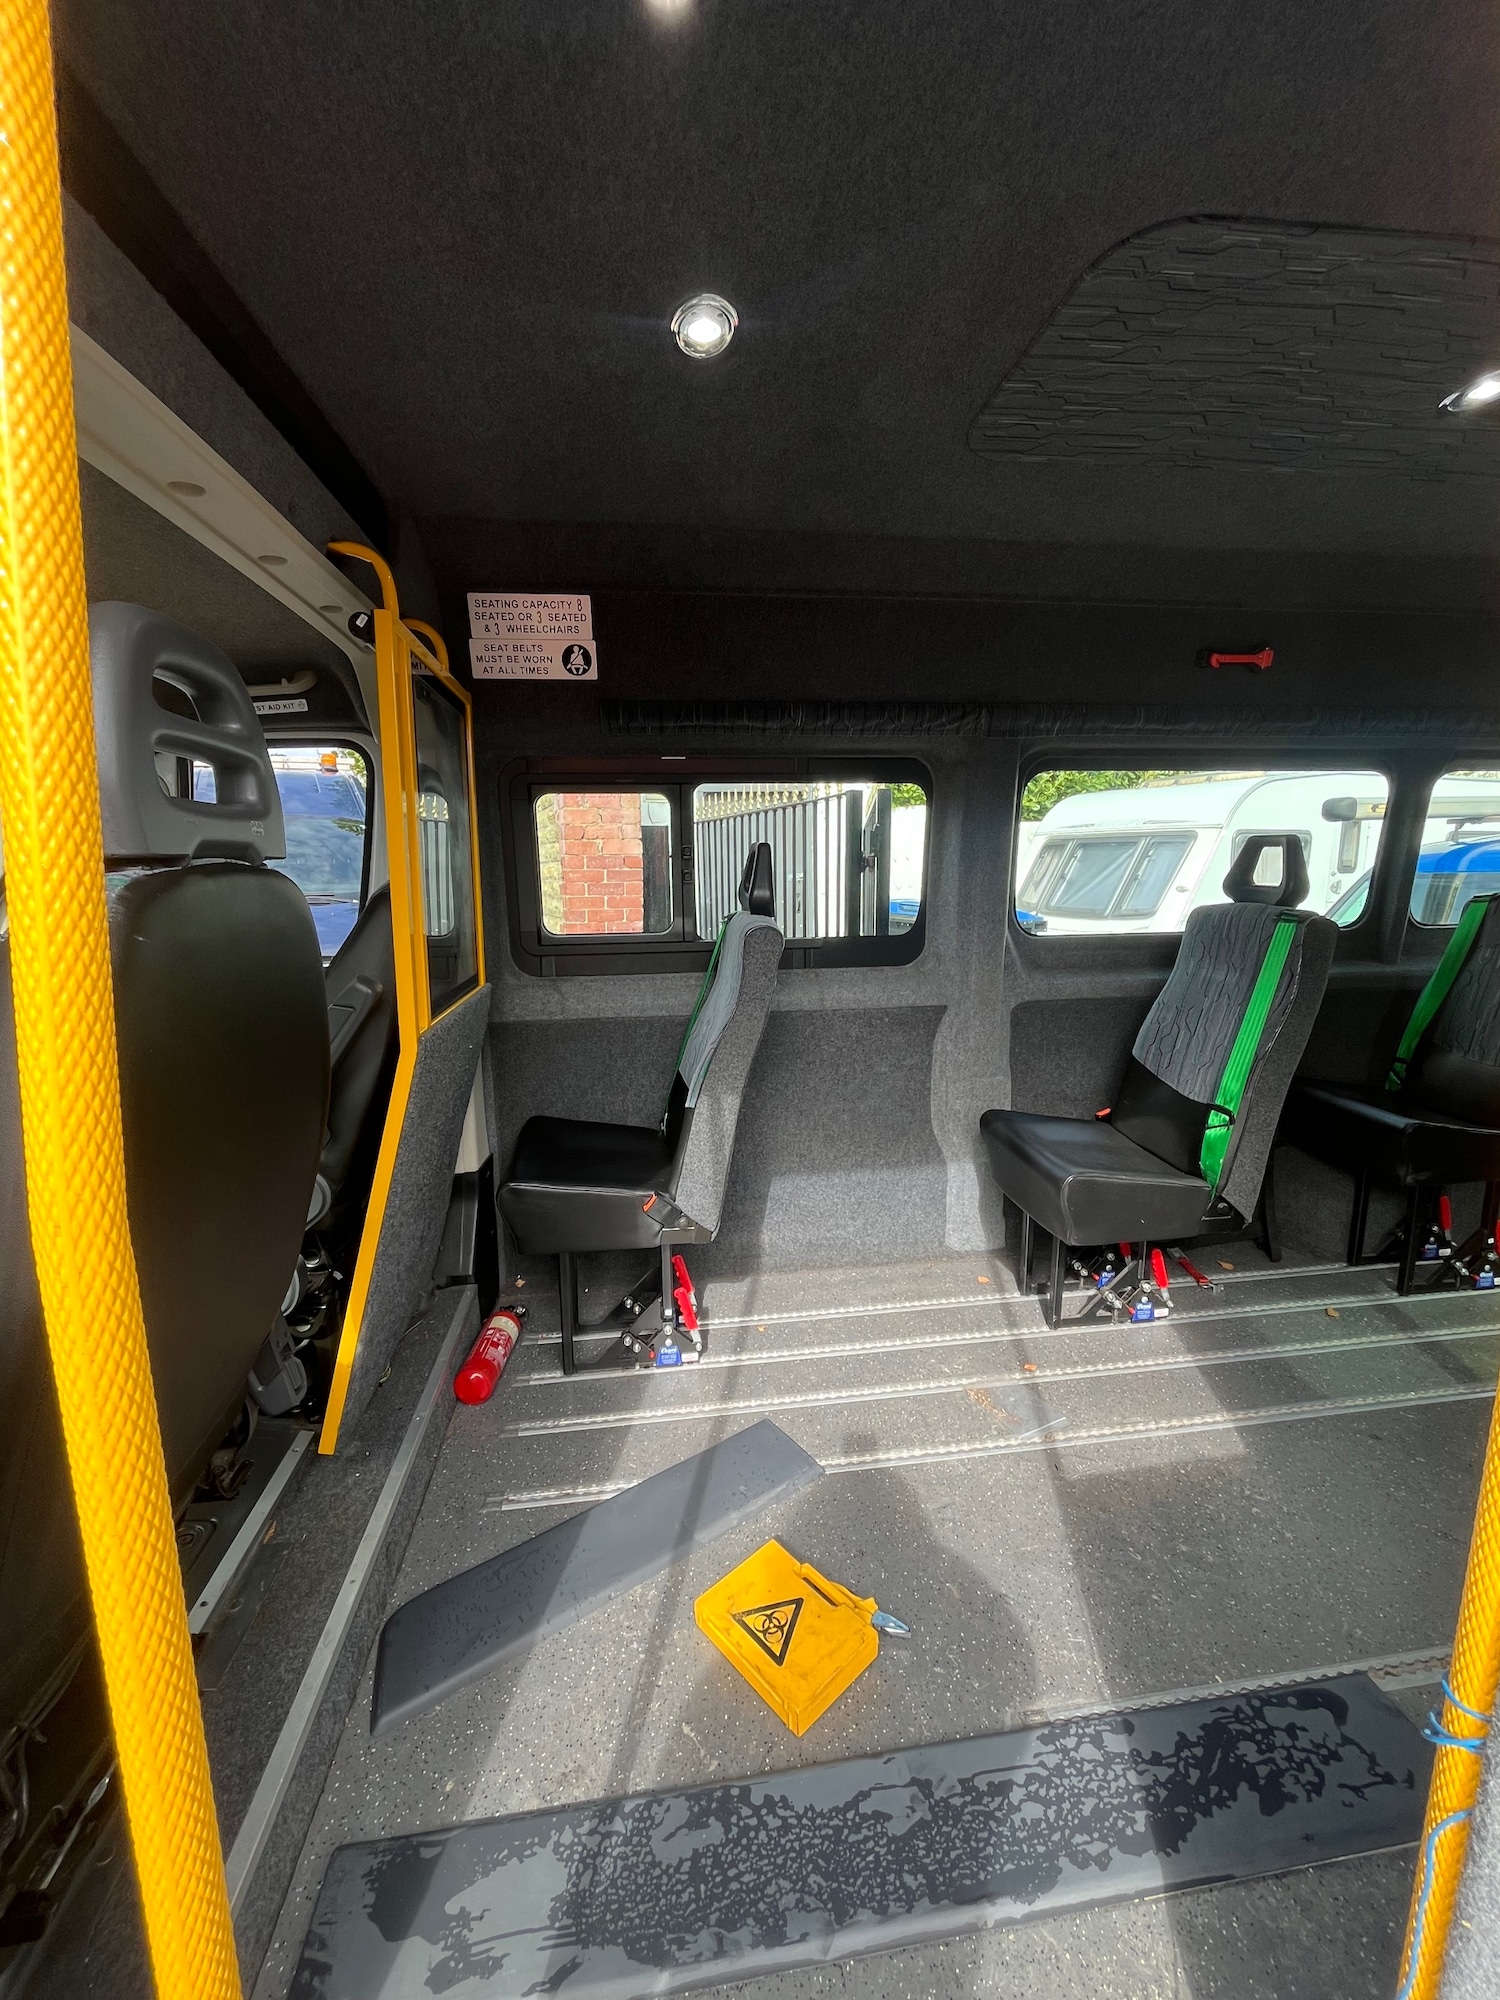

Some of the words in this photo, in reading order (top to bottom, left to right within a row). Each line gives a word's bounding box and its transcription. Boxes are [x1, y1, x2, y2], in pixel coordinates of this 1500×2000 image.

[474, 599, 519, 609] SEATING
[522, 600, 572, 609] CAPACITY
[474, 611, 515, 621] SEATED
[518, 612, 533, 621] OR
[536, 611, 542, 624] 3
[547, 613, 587, 622] SEATED
[484, 624, 491, 633] &
[494, 622, 500, 635] 3
[505, 624, 580, 634] WHEELCHAIRS
[483, 643, 509, 652] SEAT
[512, 644, 544, 653] BELTS
[475, 654, 503, 663] MUST
[506, 655, 520, 664] BE
[522, 655, 553, 664] WORN
[482, 666, 496, 674] AT
[498, 666, 517, 675] ALL
[520, 666, 549, 675] TIMES
[268, 703, 281, 711] AID
[282, 702, 295, 710] KIT
